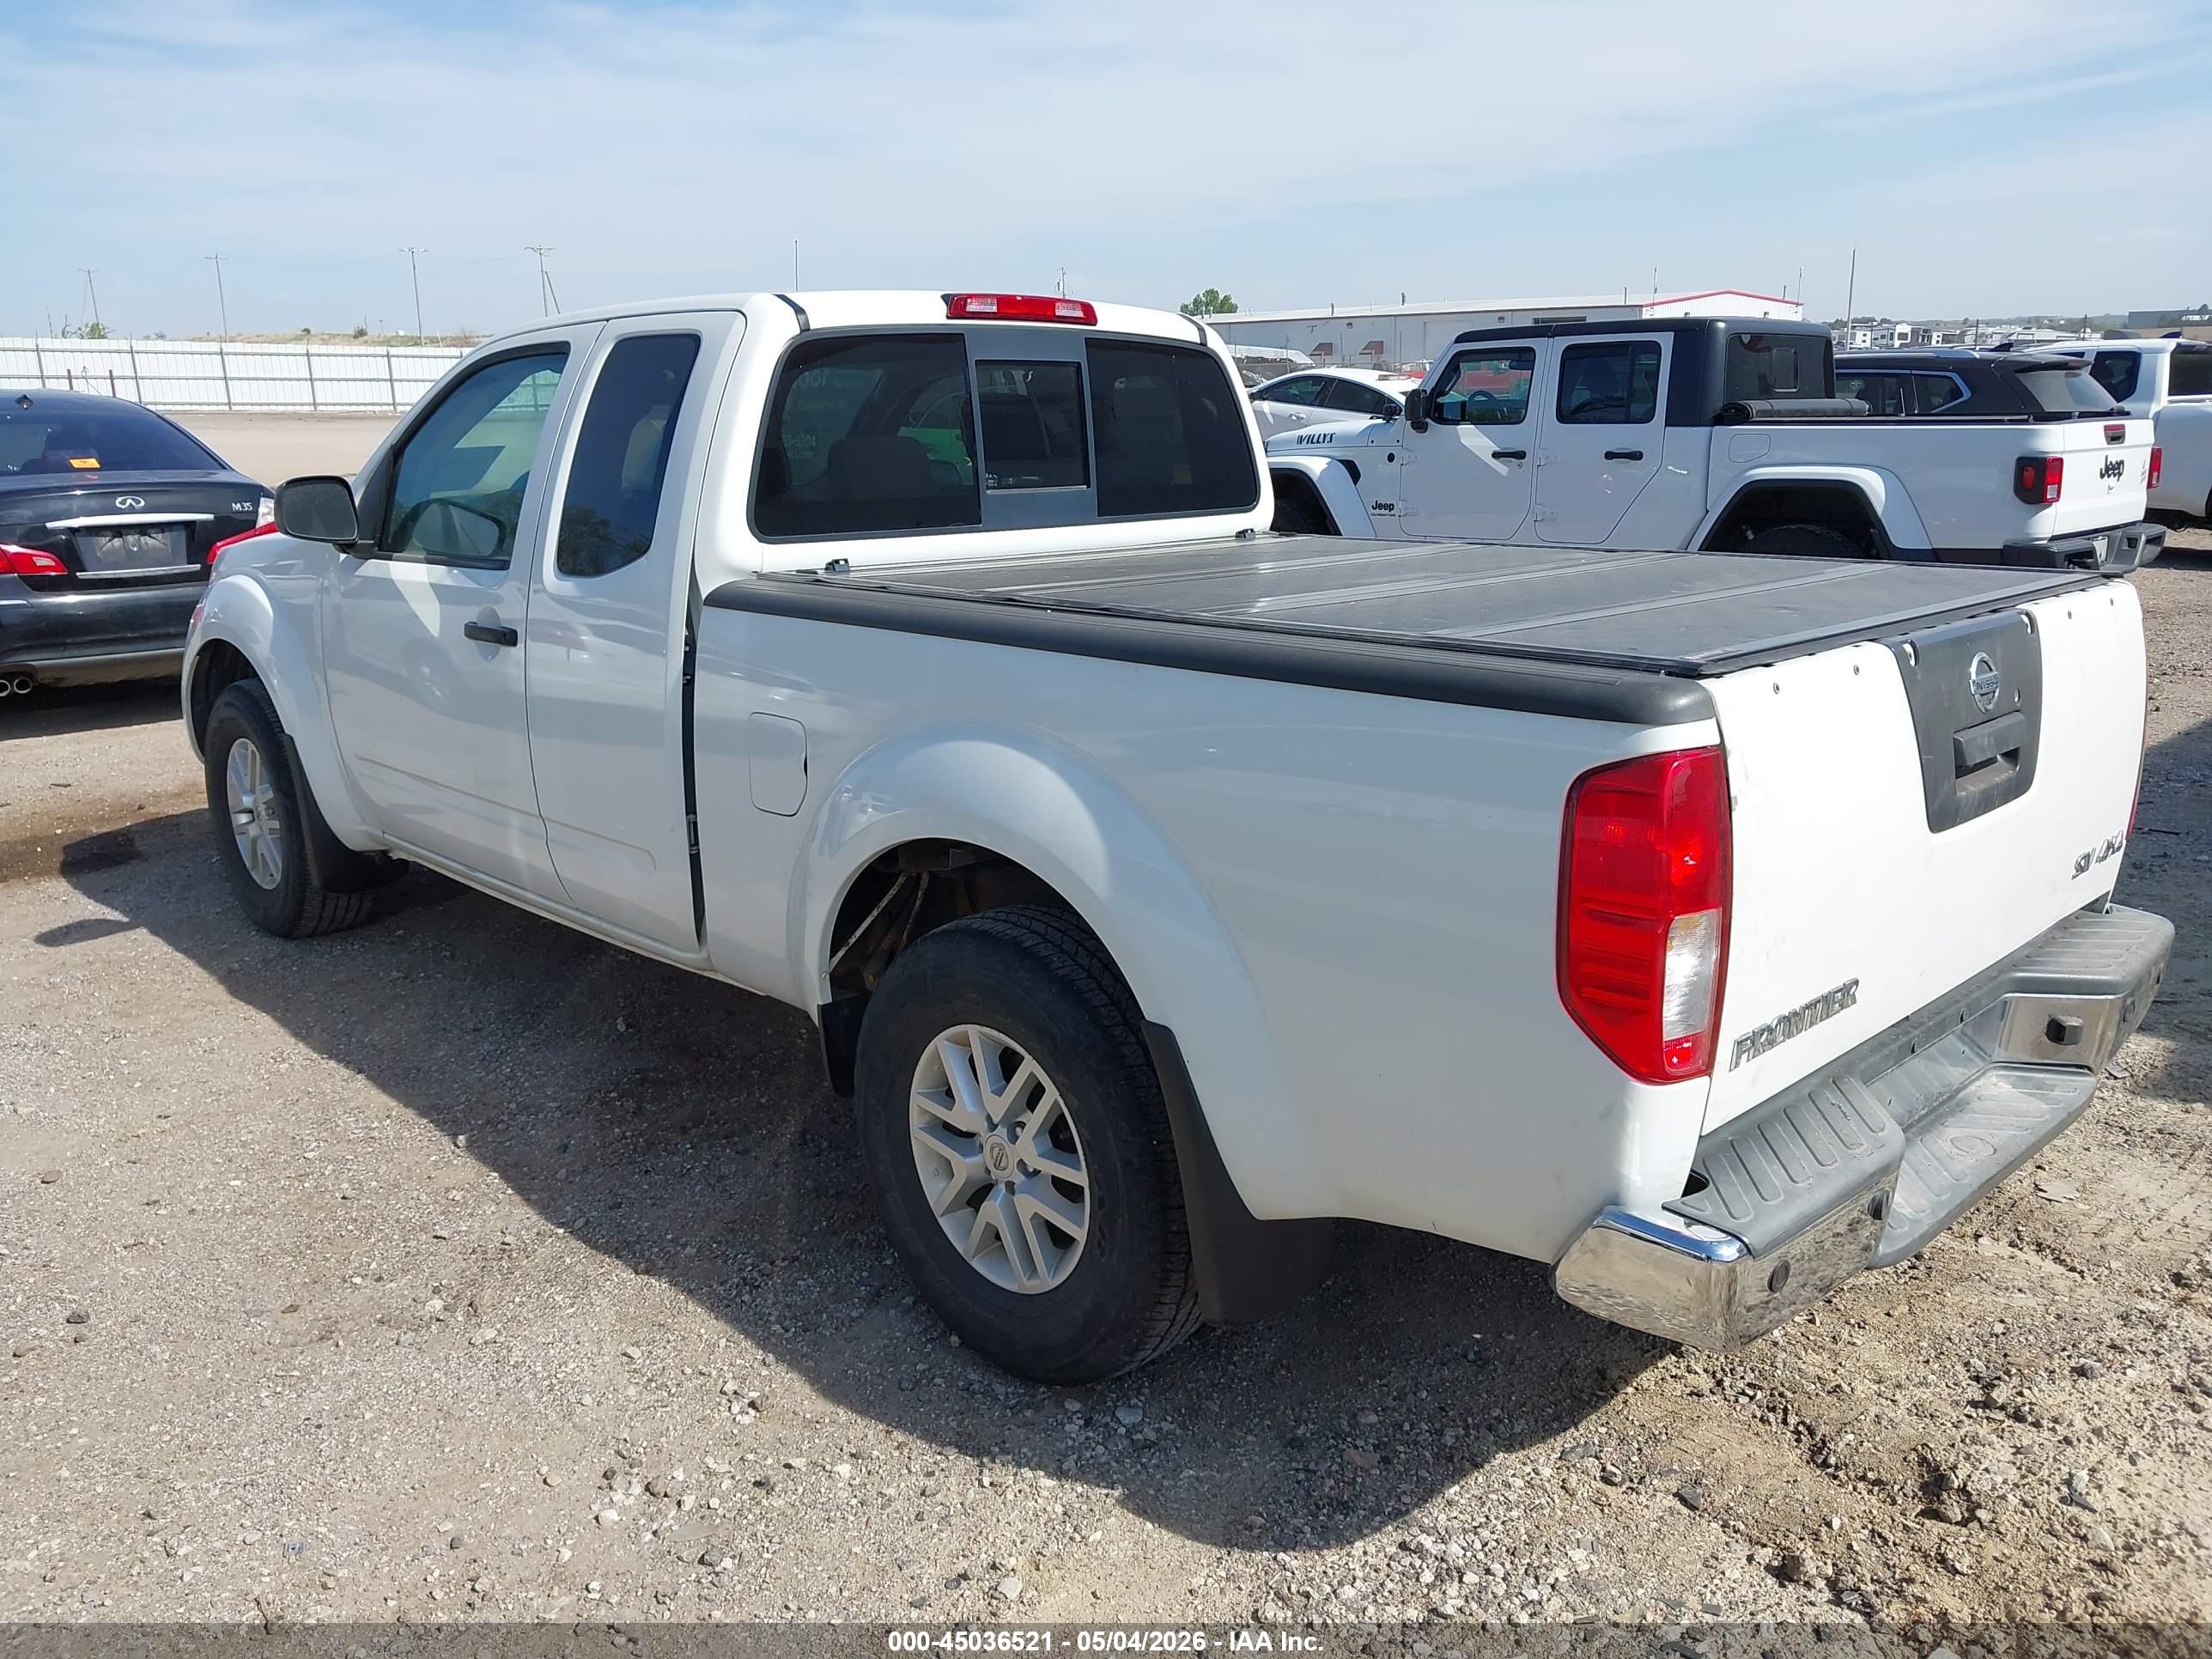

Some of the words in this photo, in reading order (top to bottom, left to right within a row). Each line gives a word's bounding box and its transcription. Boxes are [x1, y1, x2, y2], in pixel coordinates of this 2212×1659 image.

[1297, 432, 1336, 445] WILLYS
[2100, 454, 2124, 482] Jeep
[232, 501, 252, 511] M35
[1371, 500, 1395, 513] Jeep
[1729, 977, 1859, 1073] FRONTIER
